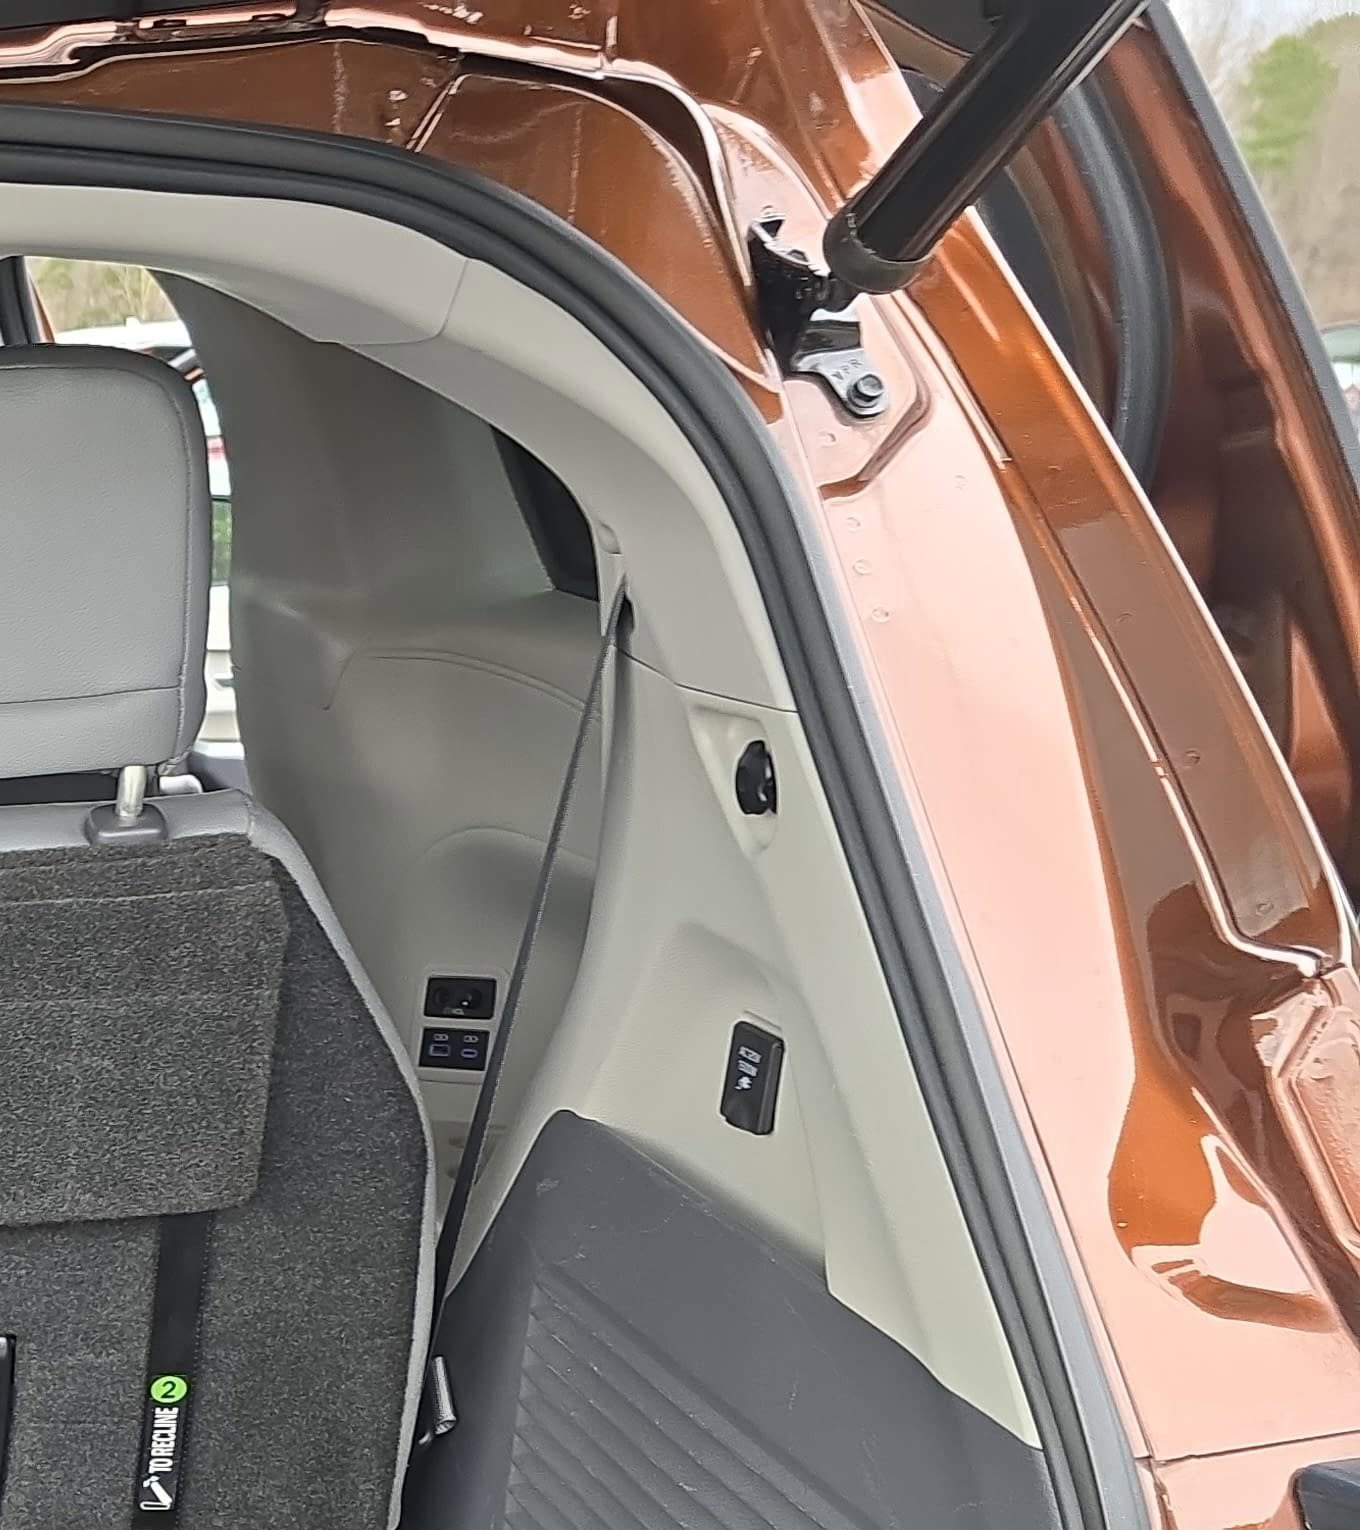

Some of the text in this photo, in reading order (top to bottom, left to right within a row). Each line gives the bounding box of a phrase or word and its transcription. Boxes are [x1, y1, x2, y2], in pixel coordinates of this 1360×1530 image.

[160, 1380, 176, 1398] 2
[148, 1406, 179, 1474] TO RECLINE
